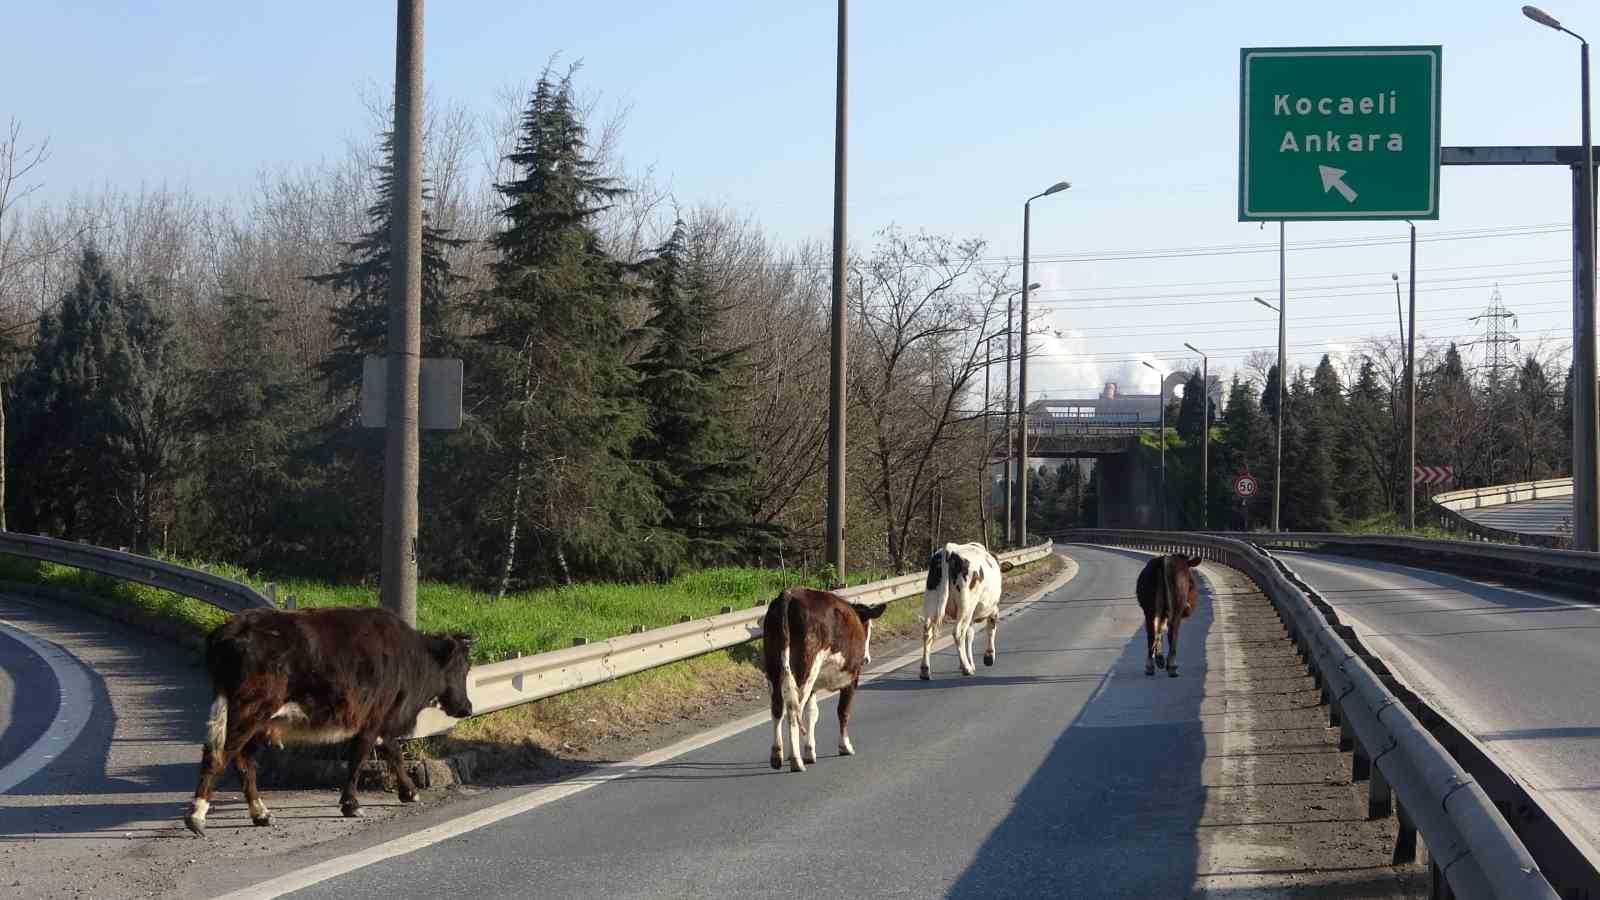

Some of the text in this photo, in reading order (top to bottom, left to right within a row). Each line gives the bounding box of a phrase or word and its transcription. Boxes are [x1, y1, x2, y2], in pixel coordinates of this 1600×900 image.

[1273, 90, 1398, 116] Kocaeli
[1279, 130, 1404, 153] Ankara
[1239, 481, 1253, 492] 50
